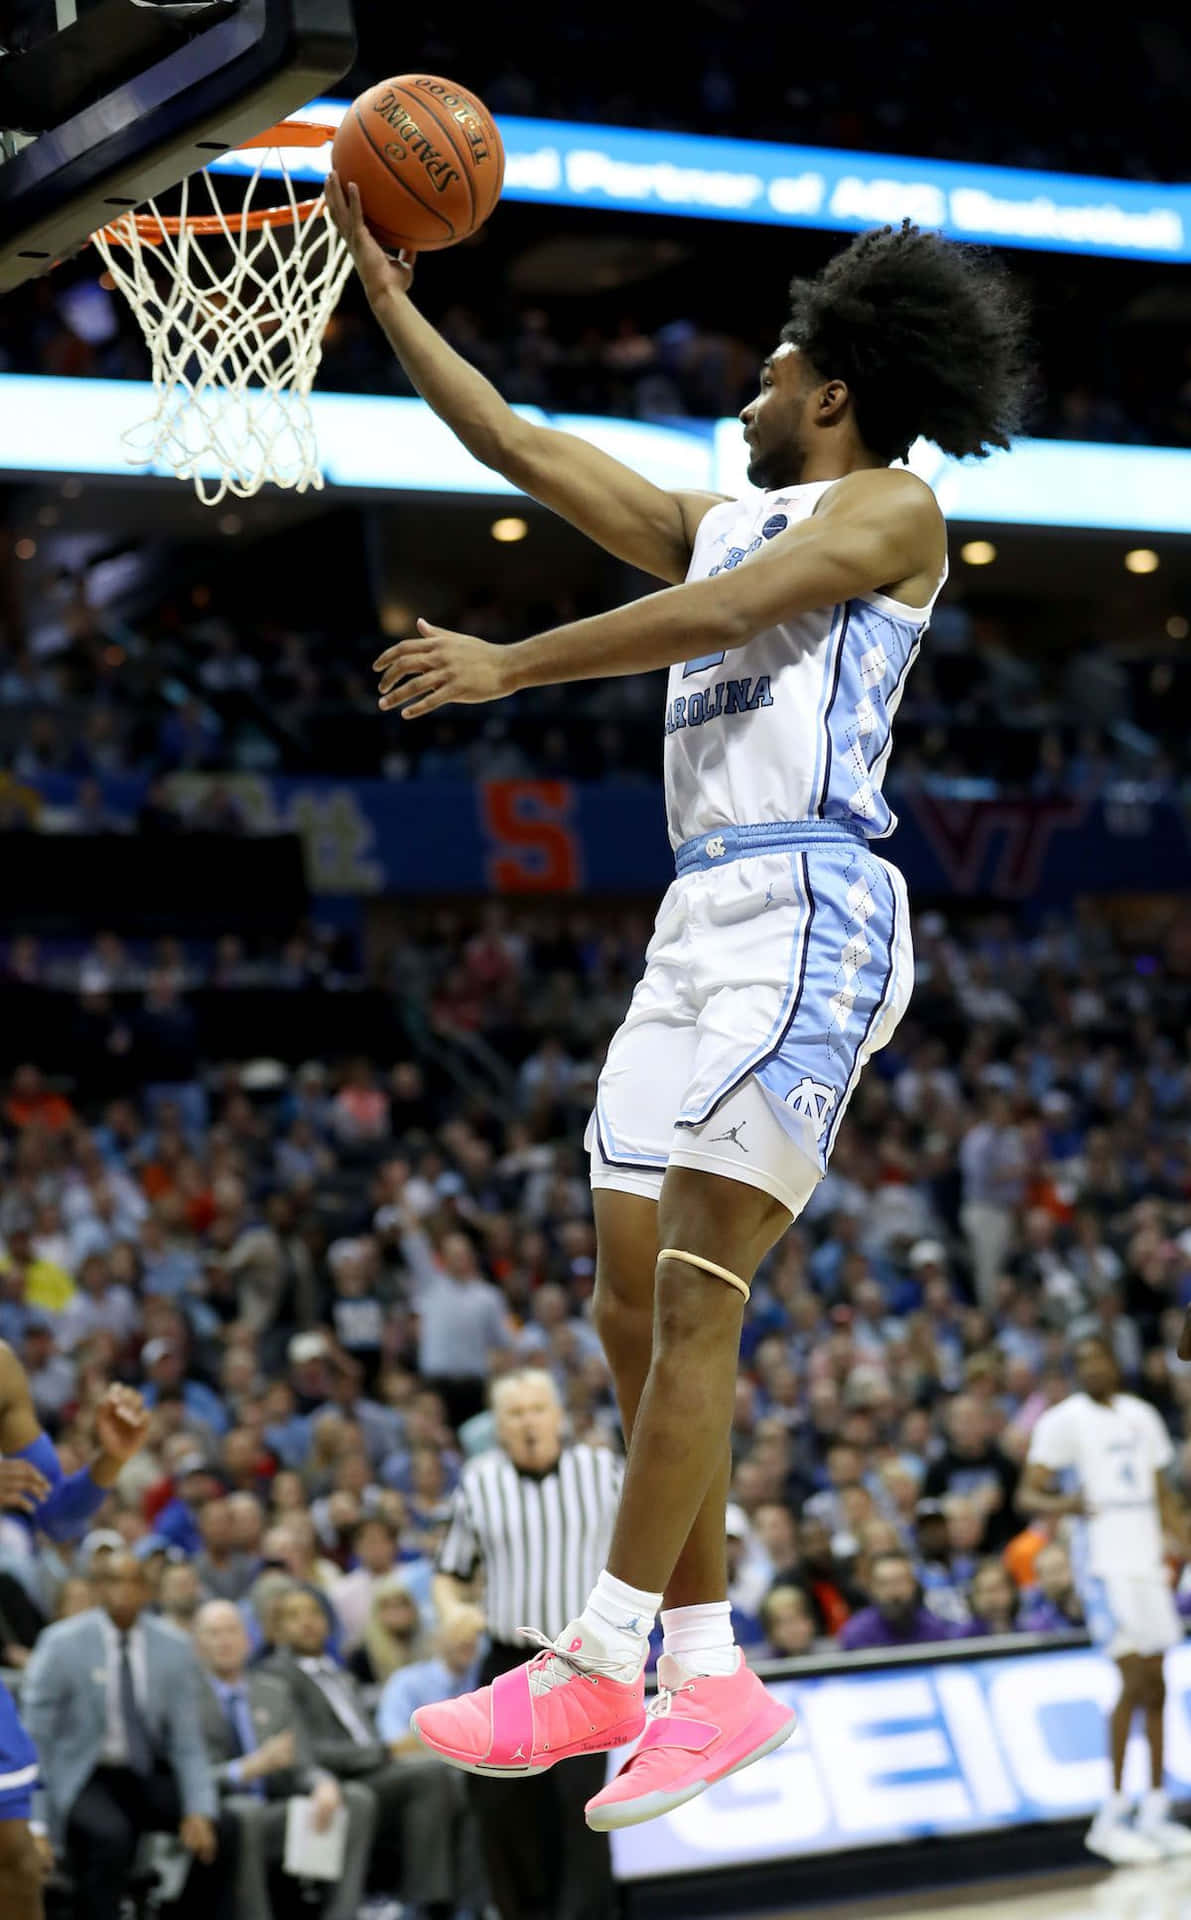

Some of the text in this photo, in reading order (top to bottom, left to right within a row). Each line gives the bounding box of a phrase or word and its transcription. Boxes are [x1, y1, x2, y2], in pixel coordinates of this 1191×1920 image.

[374, 92, 459, 192] SPALDING
[664, 676, 774, 735] AROLINA
[482, 780, 582, 892] S
[668, 1654, 1191, 1850] GEIC
